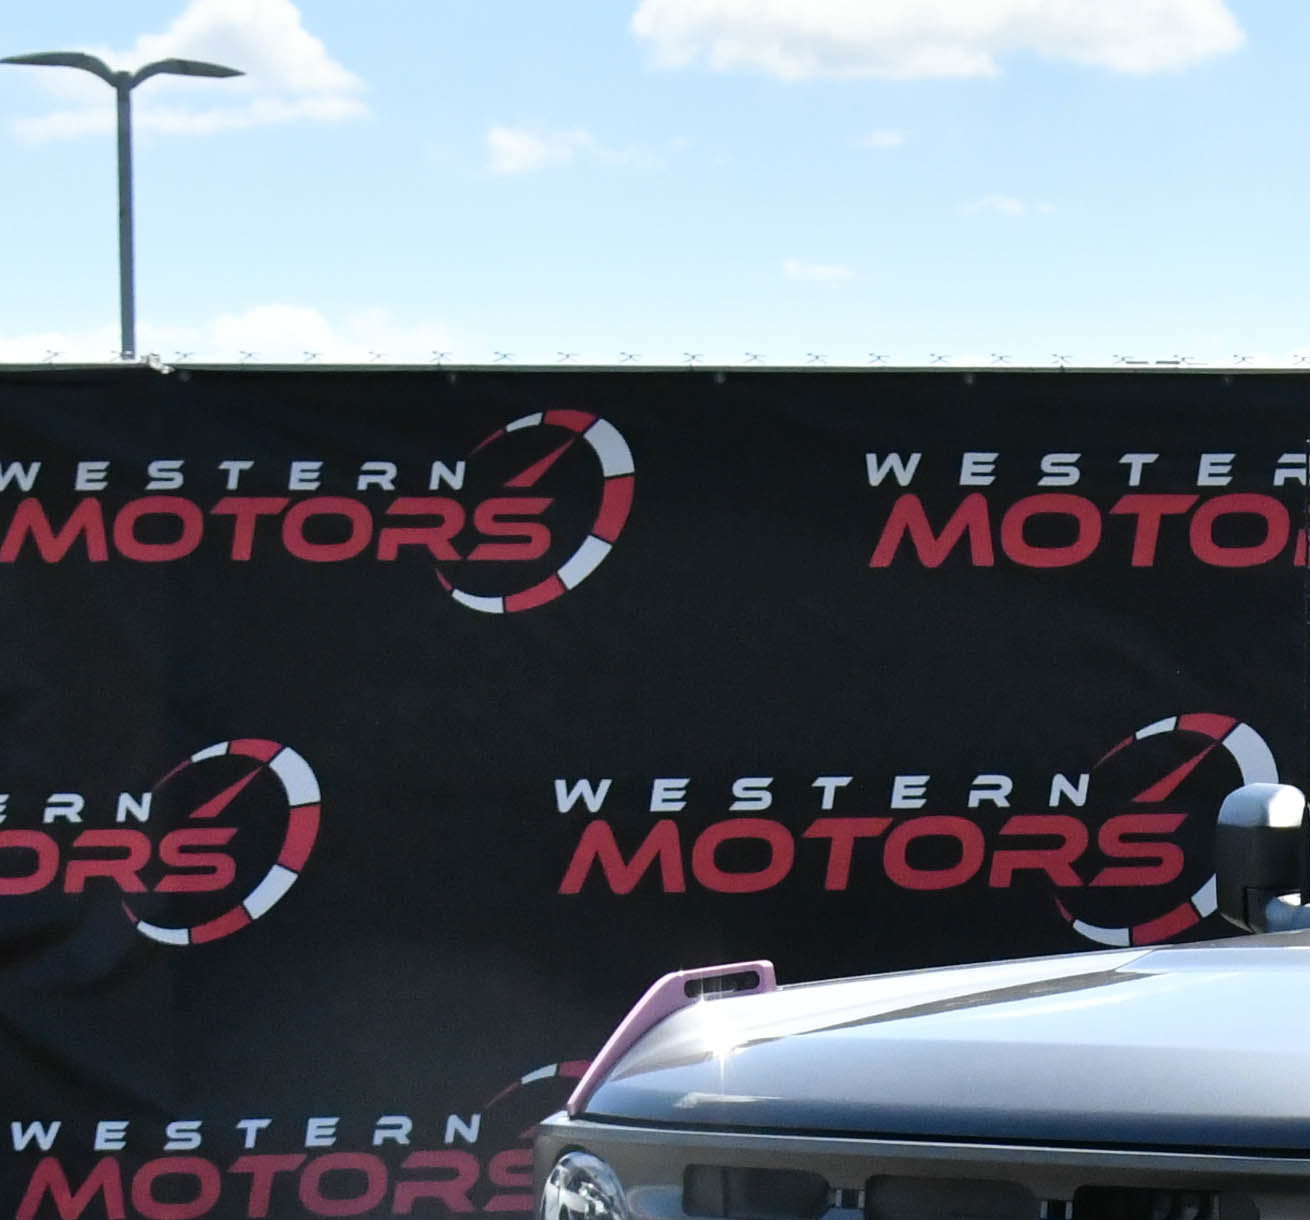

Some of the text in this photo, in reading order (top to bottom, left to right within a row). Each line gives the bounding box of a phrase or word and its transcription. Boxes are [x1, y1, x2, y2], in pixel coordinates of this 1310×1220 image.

[0, 460, 466, 491] WESTERN
[0, 496, 553, 562] MOTORS
[555, 774, 1090, 812] WESTERN
[559, 813, 1187, 894] MOTORS
[11, 1114, 481, 1150] WESTERN
